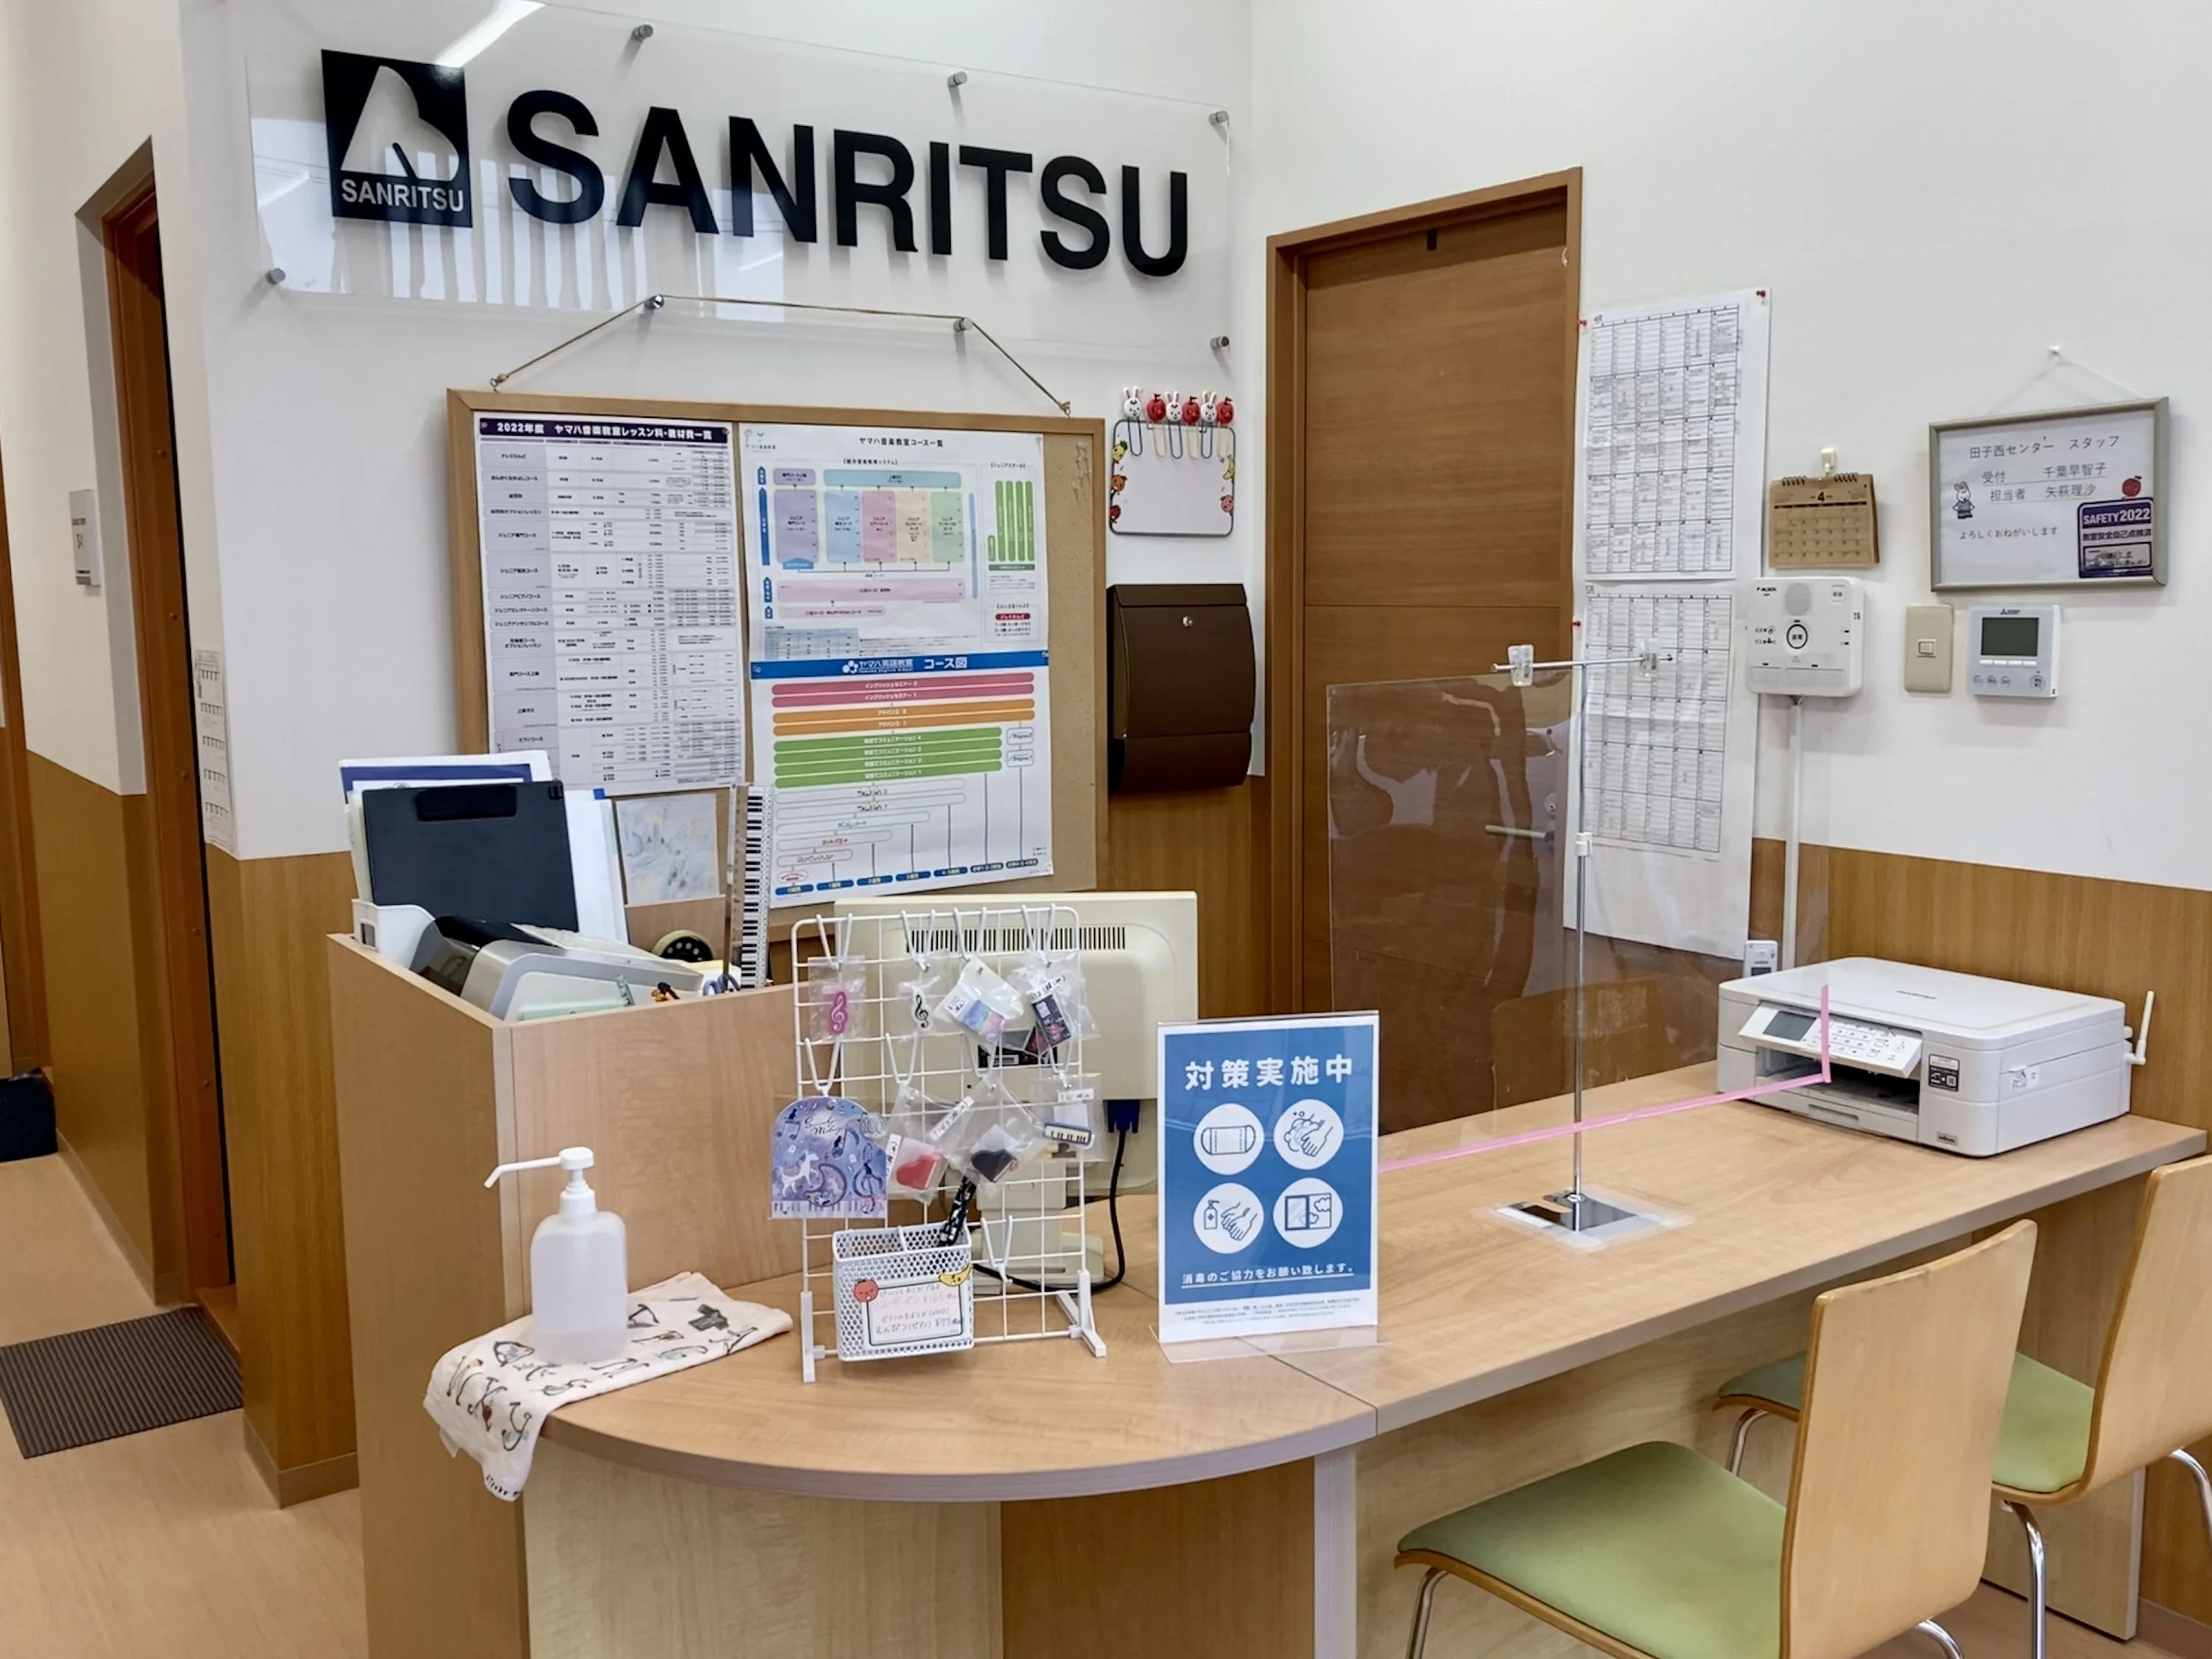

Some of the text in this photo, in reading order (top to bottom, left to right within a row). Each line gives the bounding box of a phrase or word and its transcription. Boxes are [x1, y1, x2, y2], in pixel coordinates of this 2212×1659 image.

[507, 89, 1188, 276] SANRITSU
[341, 178, 466, 214] SANRITSU
[497, 422, 545, 434] 2022年度
[859, 437, 943, 448] ヤマハ音楽教室コース一覧
[1969, 435, 2120, 459] 田子西センター スタッフ
[1982, 462, 2107, 483] 受付 千葉早智子
[1817, 491, 1826, 502] 4
[1990, 487, 2026, 501] 担当者
[2084, 508, 2151, 525] SAFETY2022
[1959, 527, 2059, 540] よろしくおねがいします
[923, 656, 967, 669] コース図
[1184, 1053, 1354, 1091] 対策実施中
[1181, 1262, 1355, 1286] 消毒のご協力をお願い致します。
